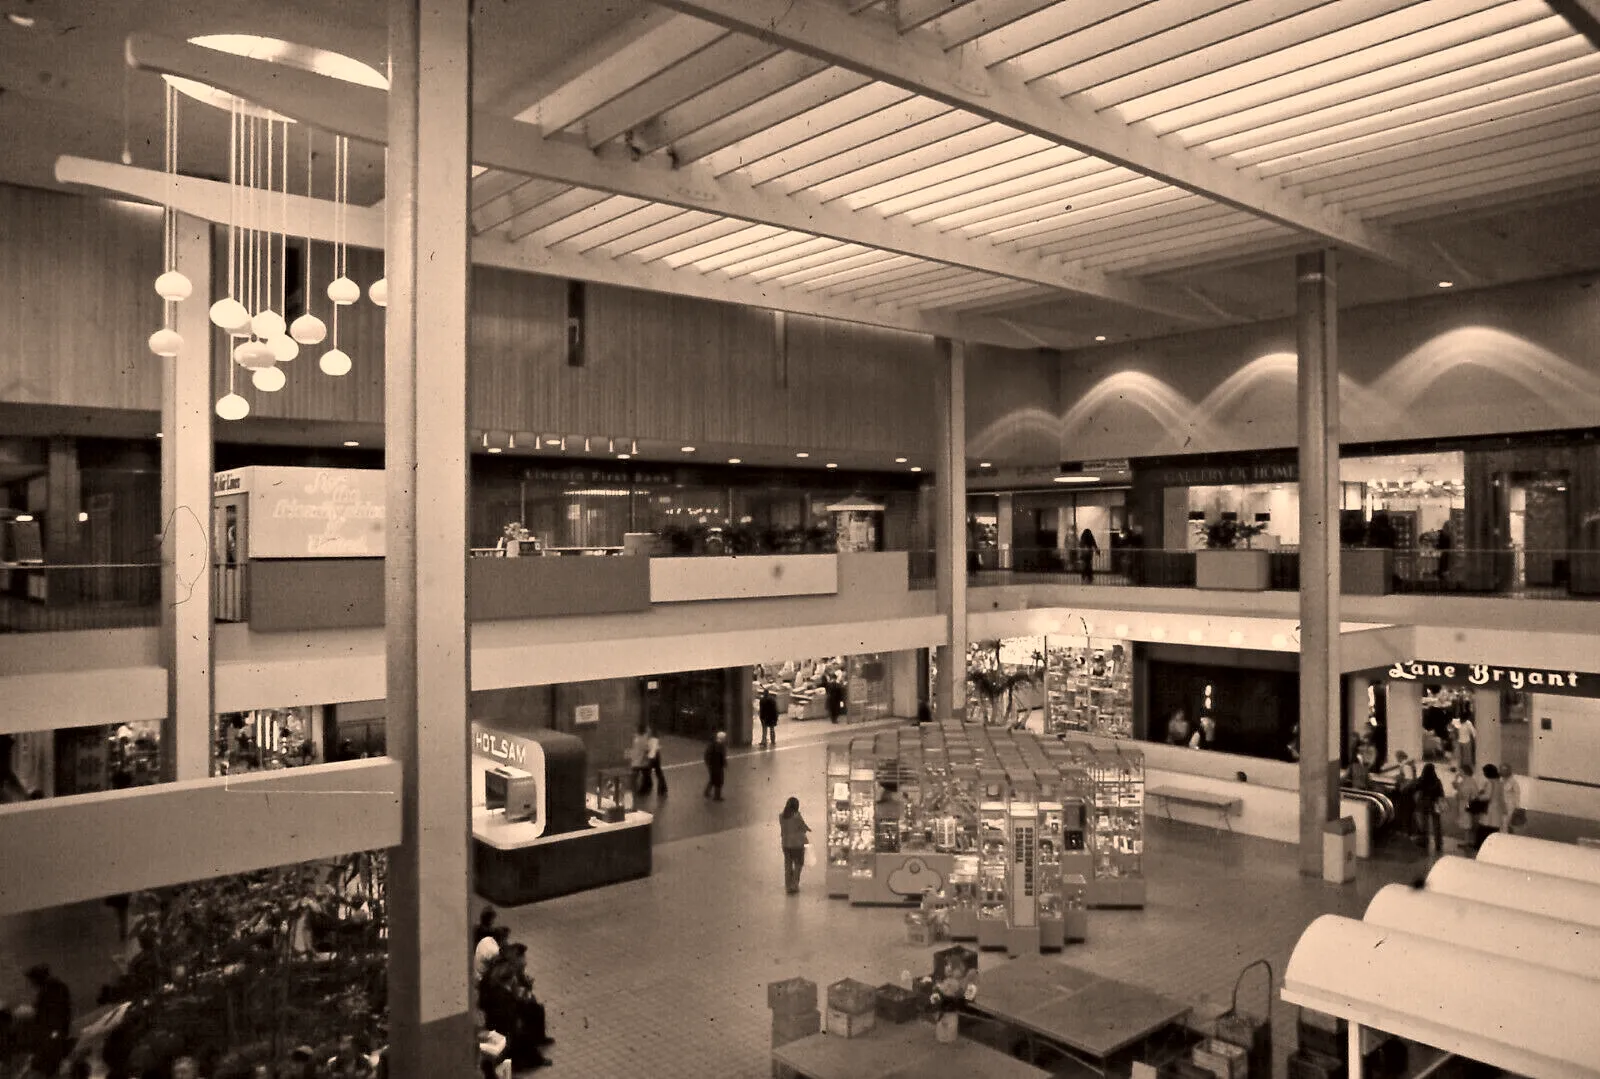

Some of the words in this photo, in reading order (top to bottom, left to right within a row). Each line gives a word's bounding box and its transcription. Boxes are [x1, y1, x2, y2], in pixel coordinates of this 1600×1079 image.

[592, 470, 627, 482] First
[635, 472, 671, 483] Bank
[1388, 659, 1456, 680] Lane
[1468, 664, 1579, 689] Bryant
[475, 732, 501, 756] HOT
[501, 739, 526, 763] SAM
